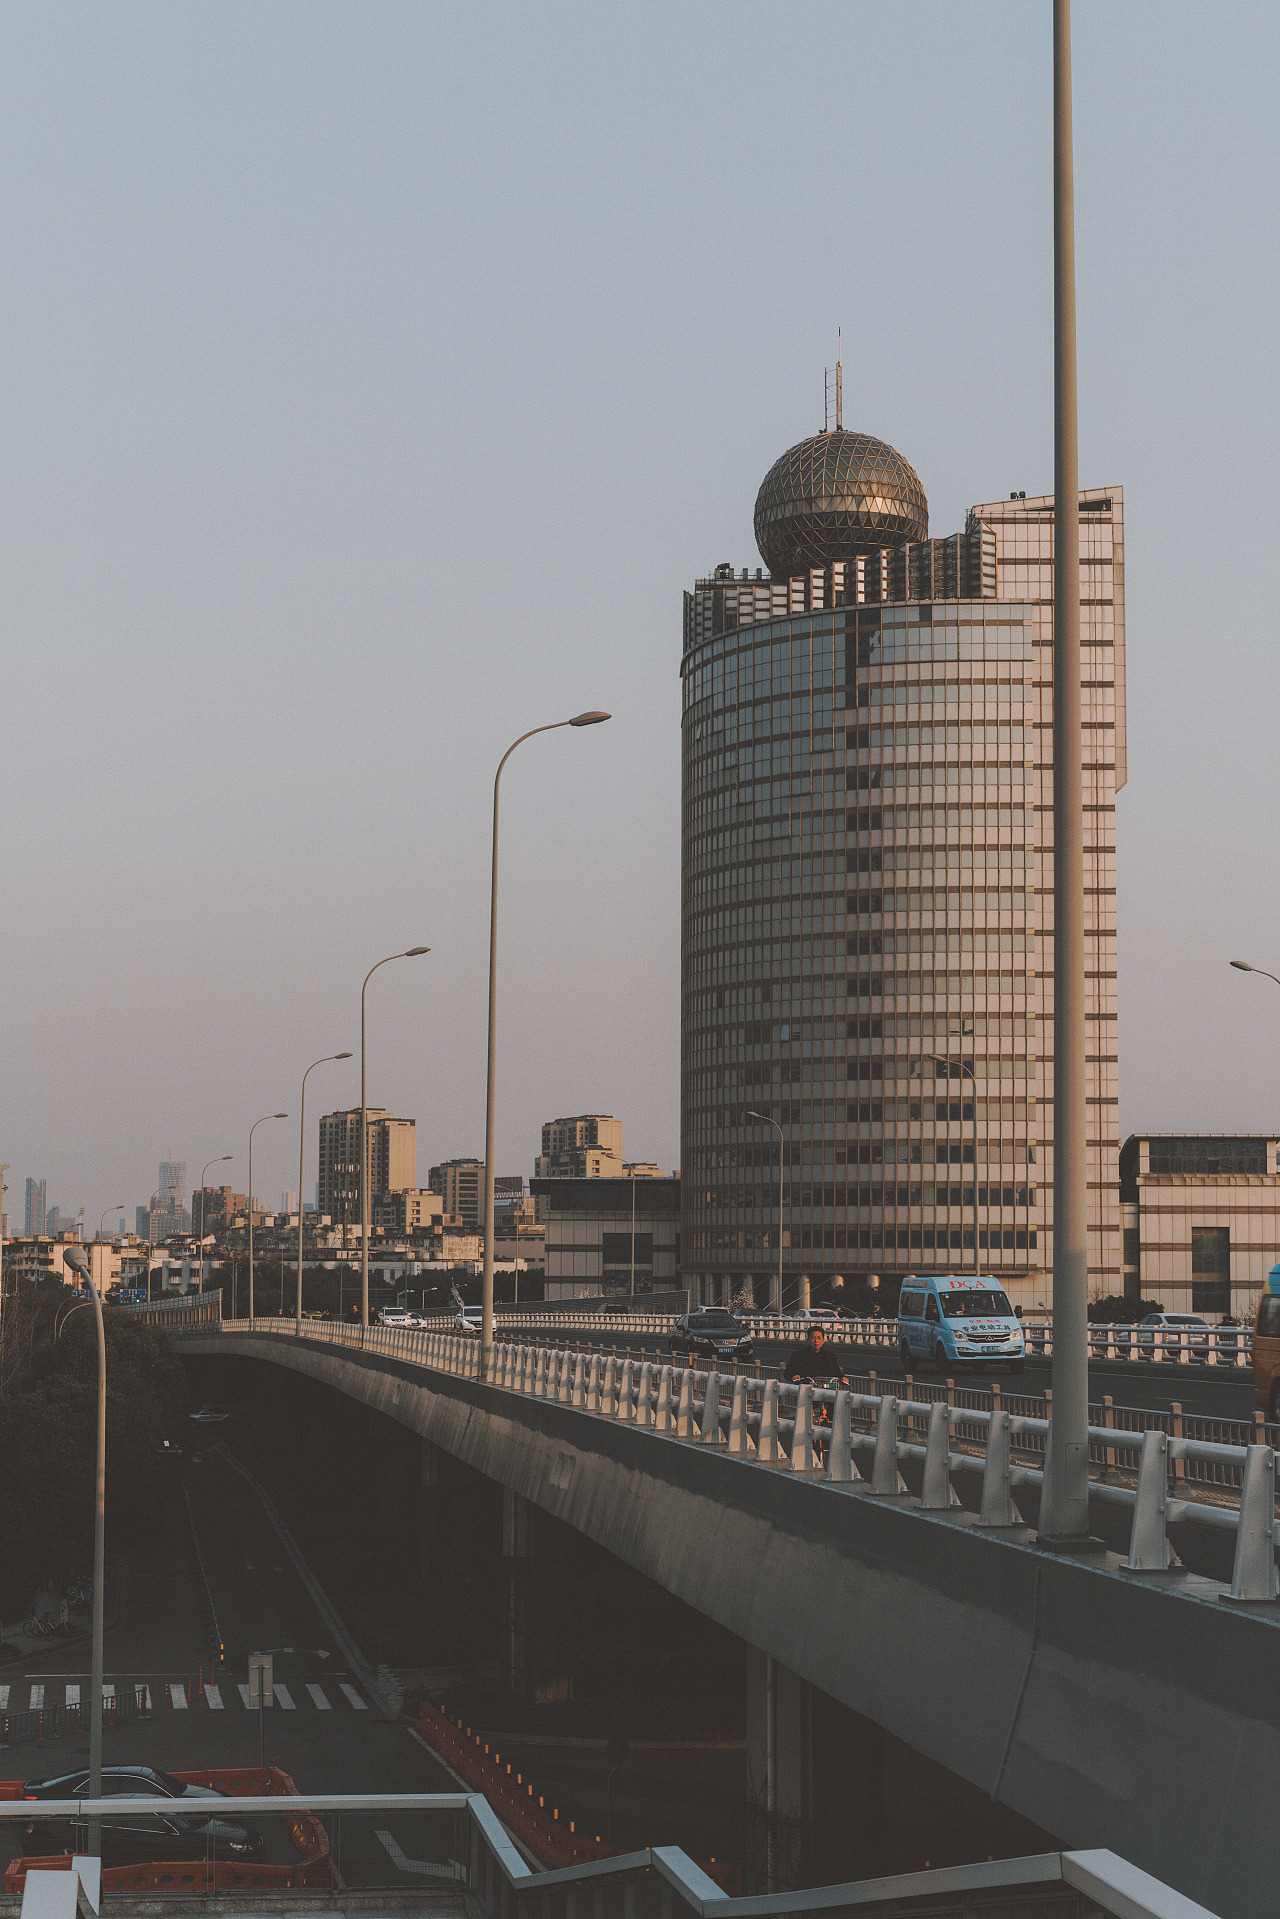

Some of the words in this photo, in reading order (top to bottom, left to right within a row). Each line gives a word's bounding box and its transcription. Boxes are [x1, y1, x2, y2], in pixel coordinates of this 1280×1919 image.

[949, 1280, 987, 1288] DCA
[962, 1324, 1011, 1332] 专业电动工具
